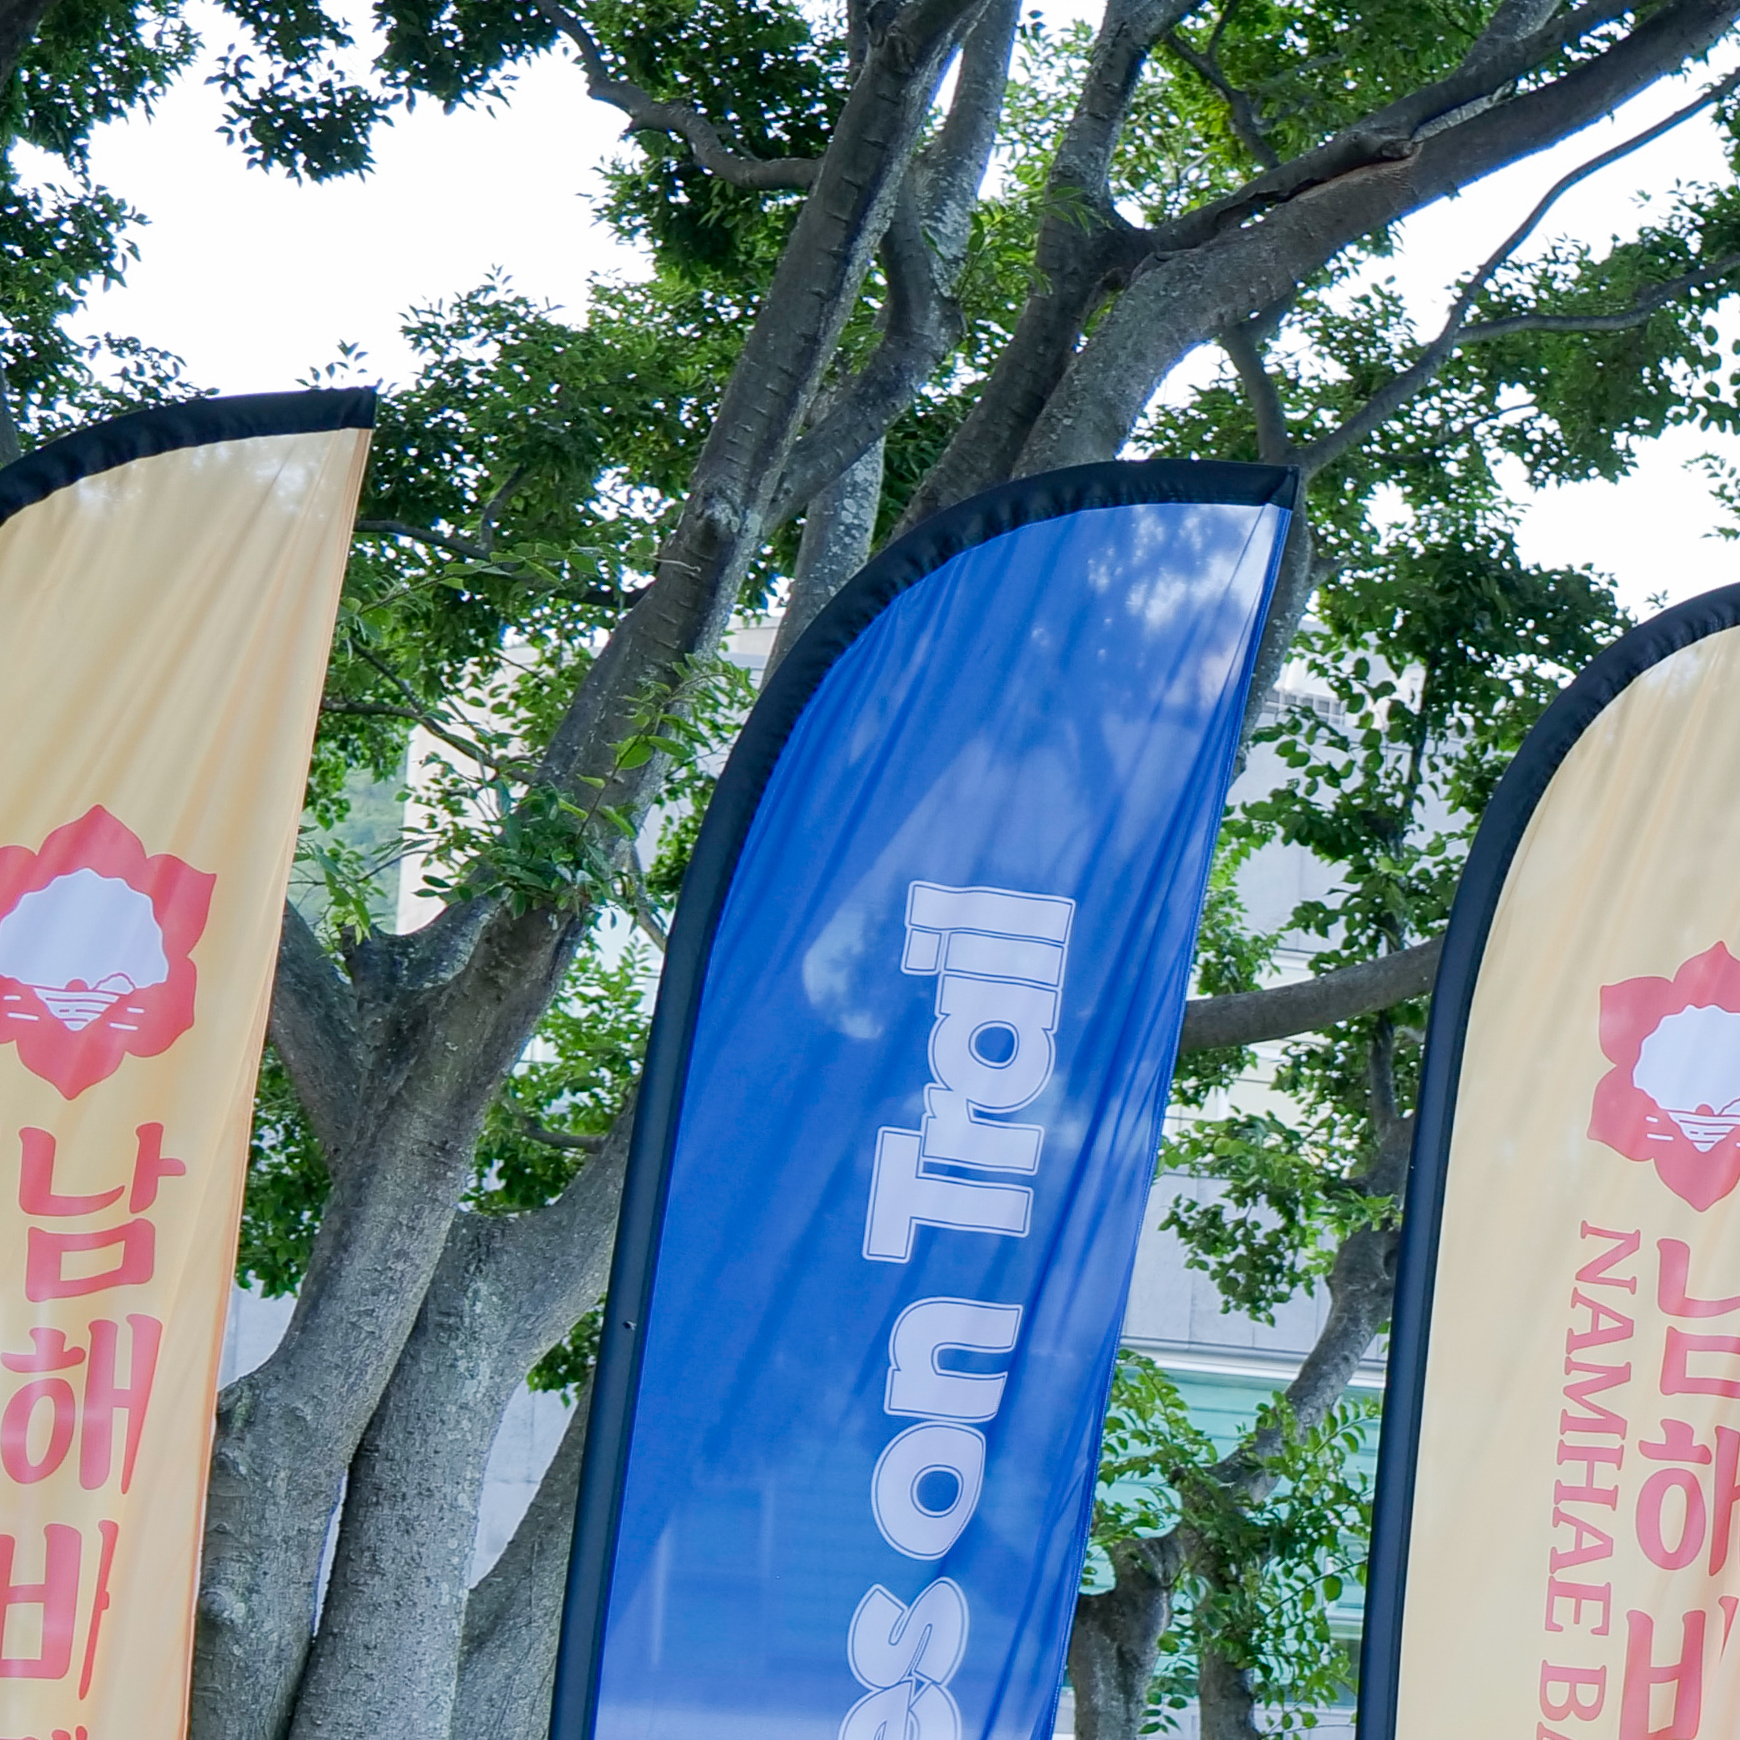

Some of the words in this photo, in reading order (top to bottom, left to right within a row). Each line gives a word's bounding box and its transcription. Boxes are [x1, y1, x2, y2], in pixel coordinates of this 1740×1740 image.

[861, 880, 1076, 1263] Trail
[870, 1295, 1023, 1560] on
[1537, 1219, 1642, 1636] NAMHAE
